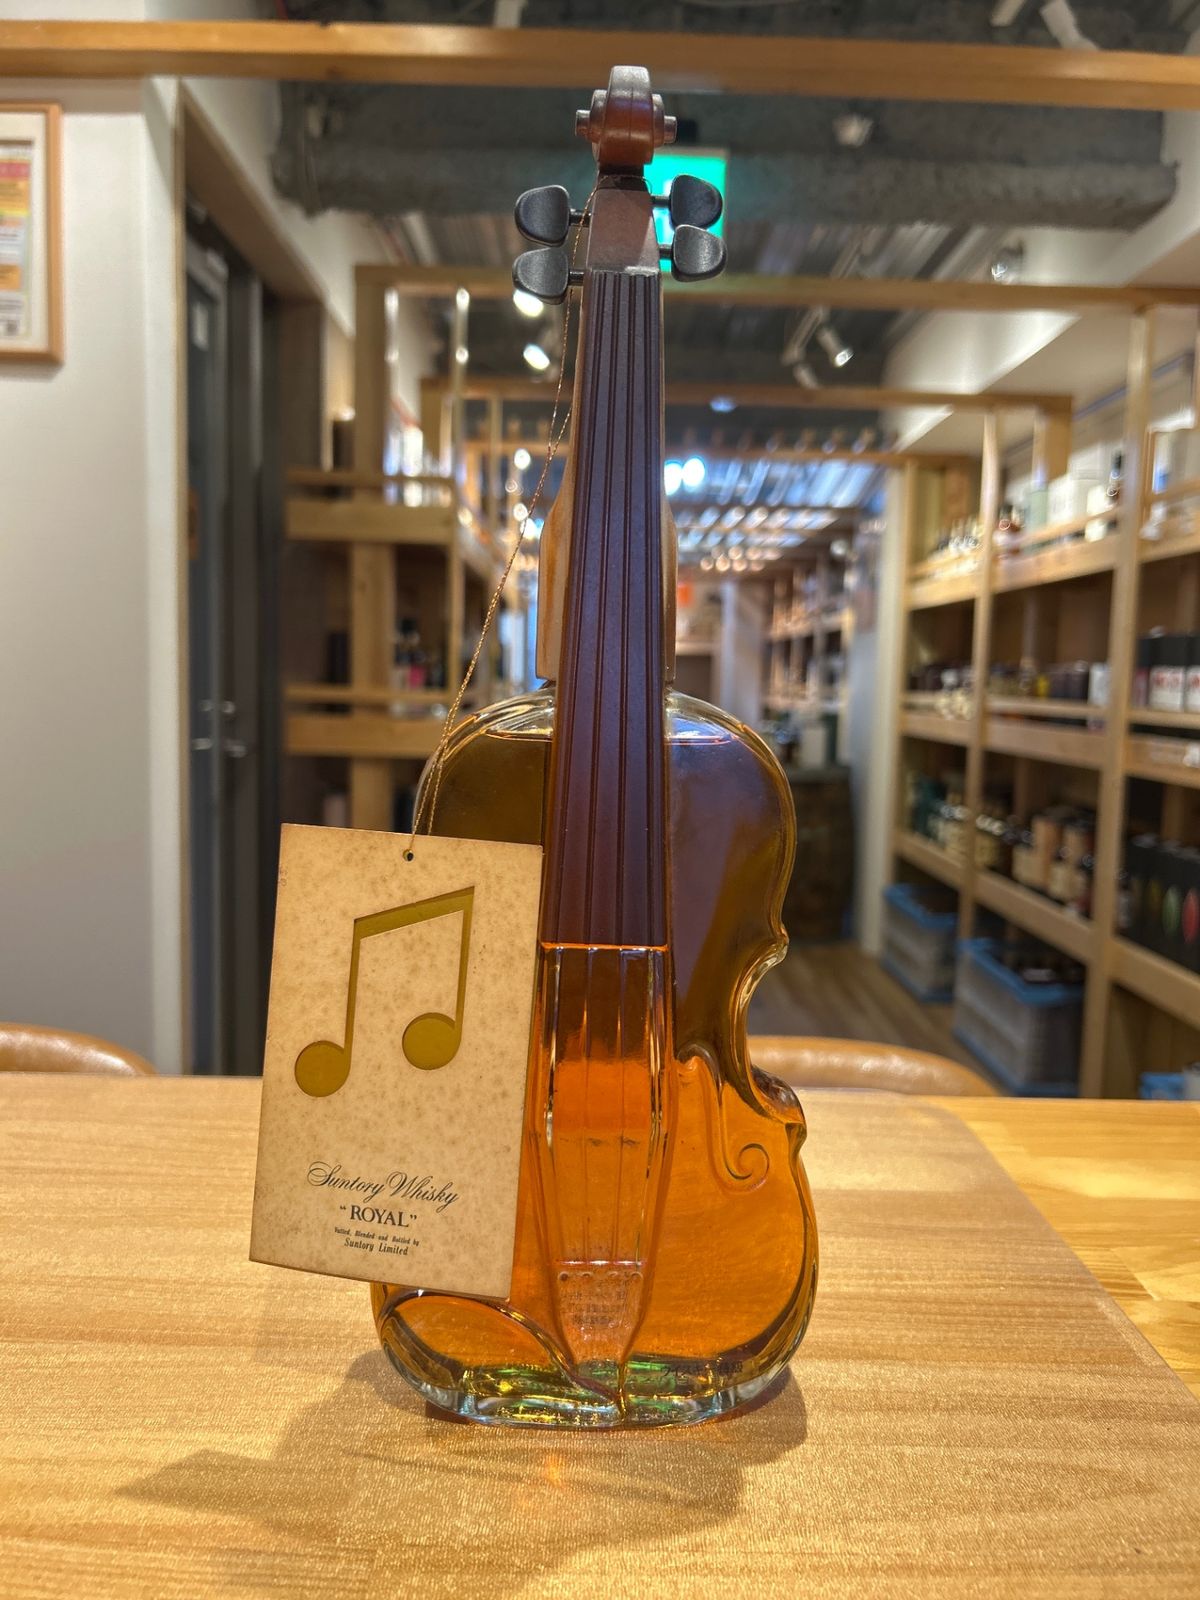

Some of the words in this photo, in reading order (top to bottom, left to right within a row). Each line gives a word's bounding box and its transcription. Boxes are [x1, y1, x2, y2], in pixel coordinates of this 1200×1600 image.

[307, 1161, 385, 1203] Suntory
[386, 1171, 460, 1213] Whisky
[344, 1237, 374, 1252] Suntory
[378, 1242, 409, 1256] Limited
[355, 1230, 375, 1239] Blended
[378, 1234, 389, 1242] and
[392, 1236, 411, 1245] Bottled
[413, 1238, 419, 1247] by
